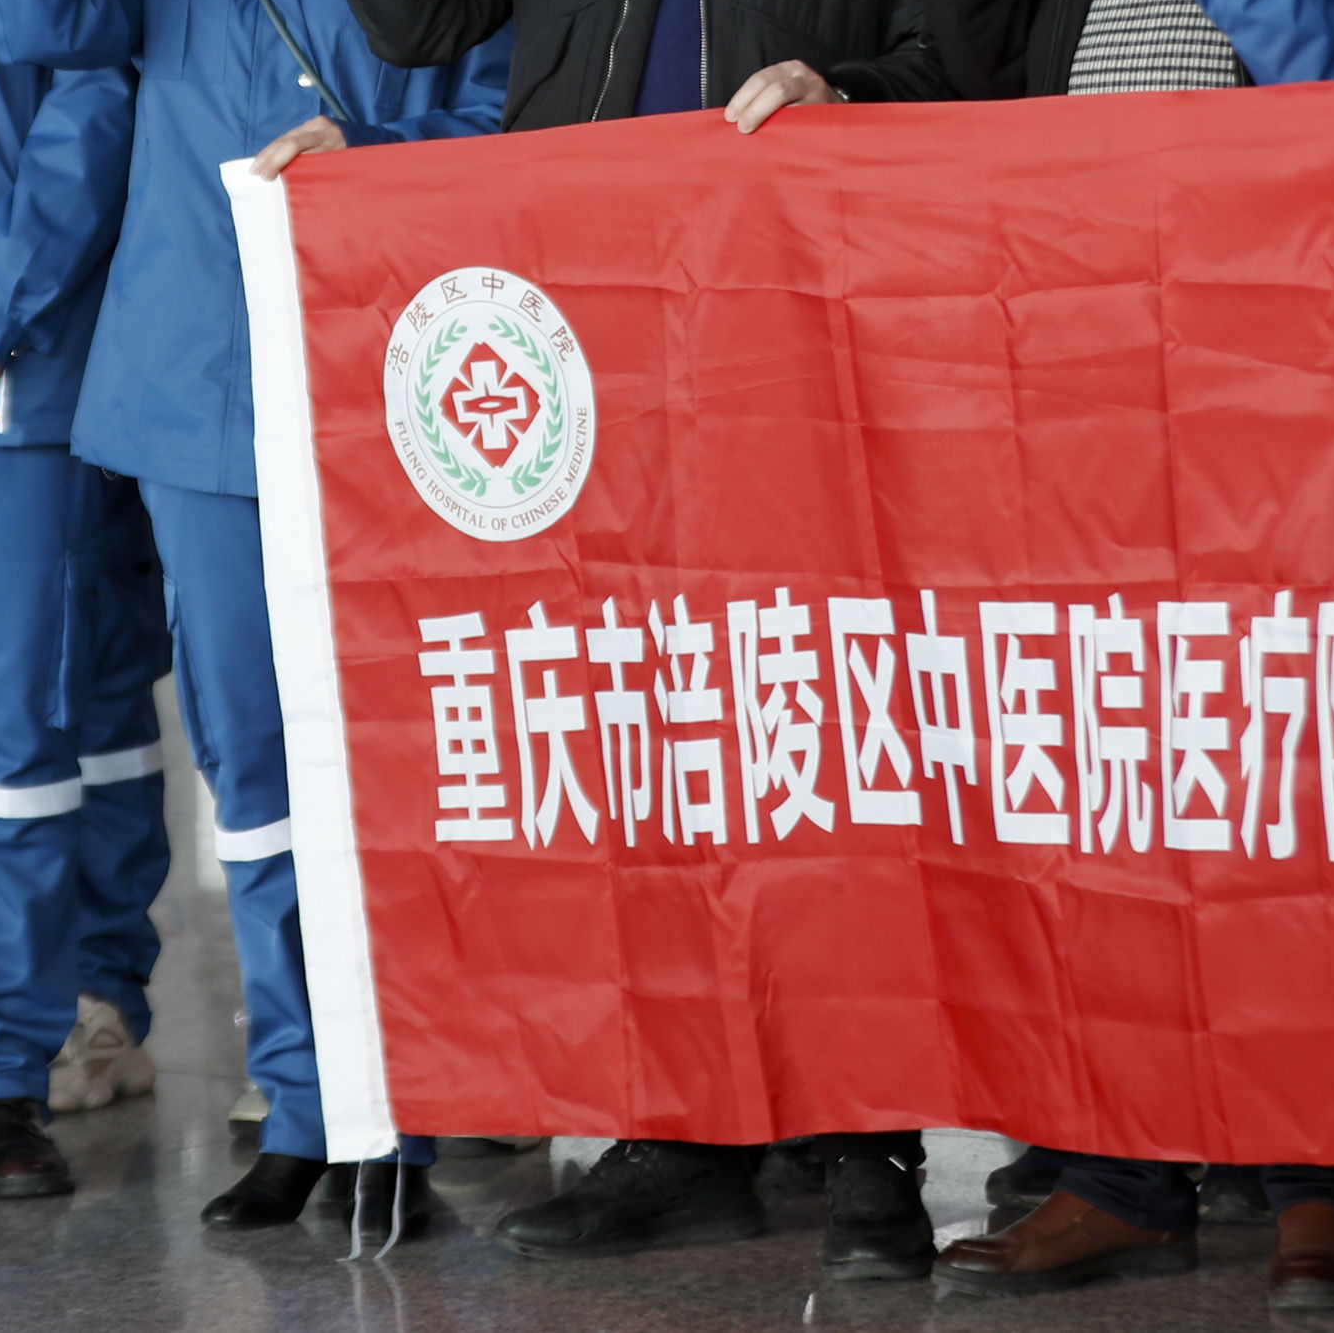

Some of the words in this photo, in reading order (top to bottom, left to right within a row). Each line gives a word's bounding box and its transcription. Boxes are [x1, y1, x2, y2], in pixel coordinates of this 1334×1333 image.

[386, 271, 575, 376] 涪陵区中医院
[394, 419, 427, 482] FULING
[427, 479, 487, 530] HOSPITAL
[490, 516, 508, 532] OF
[510, 487, 568, 531] CHINESE
[564, 405, 588, 488] MEDICINE
